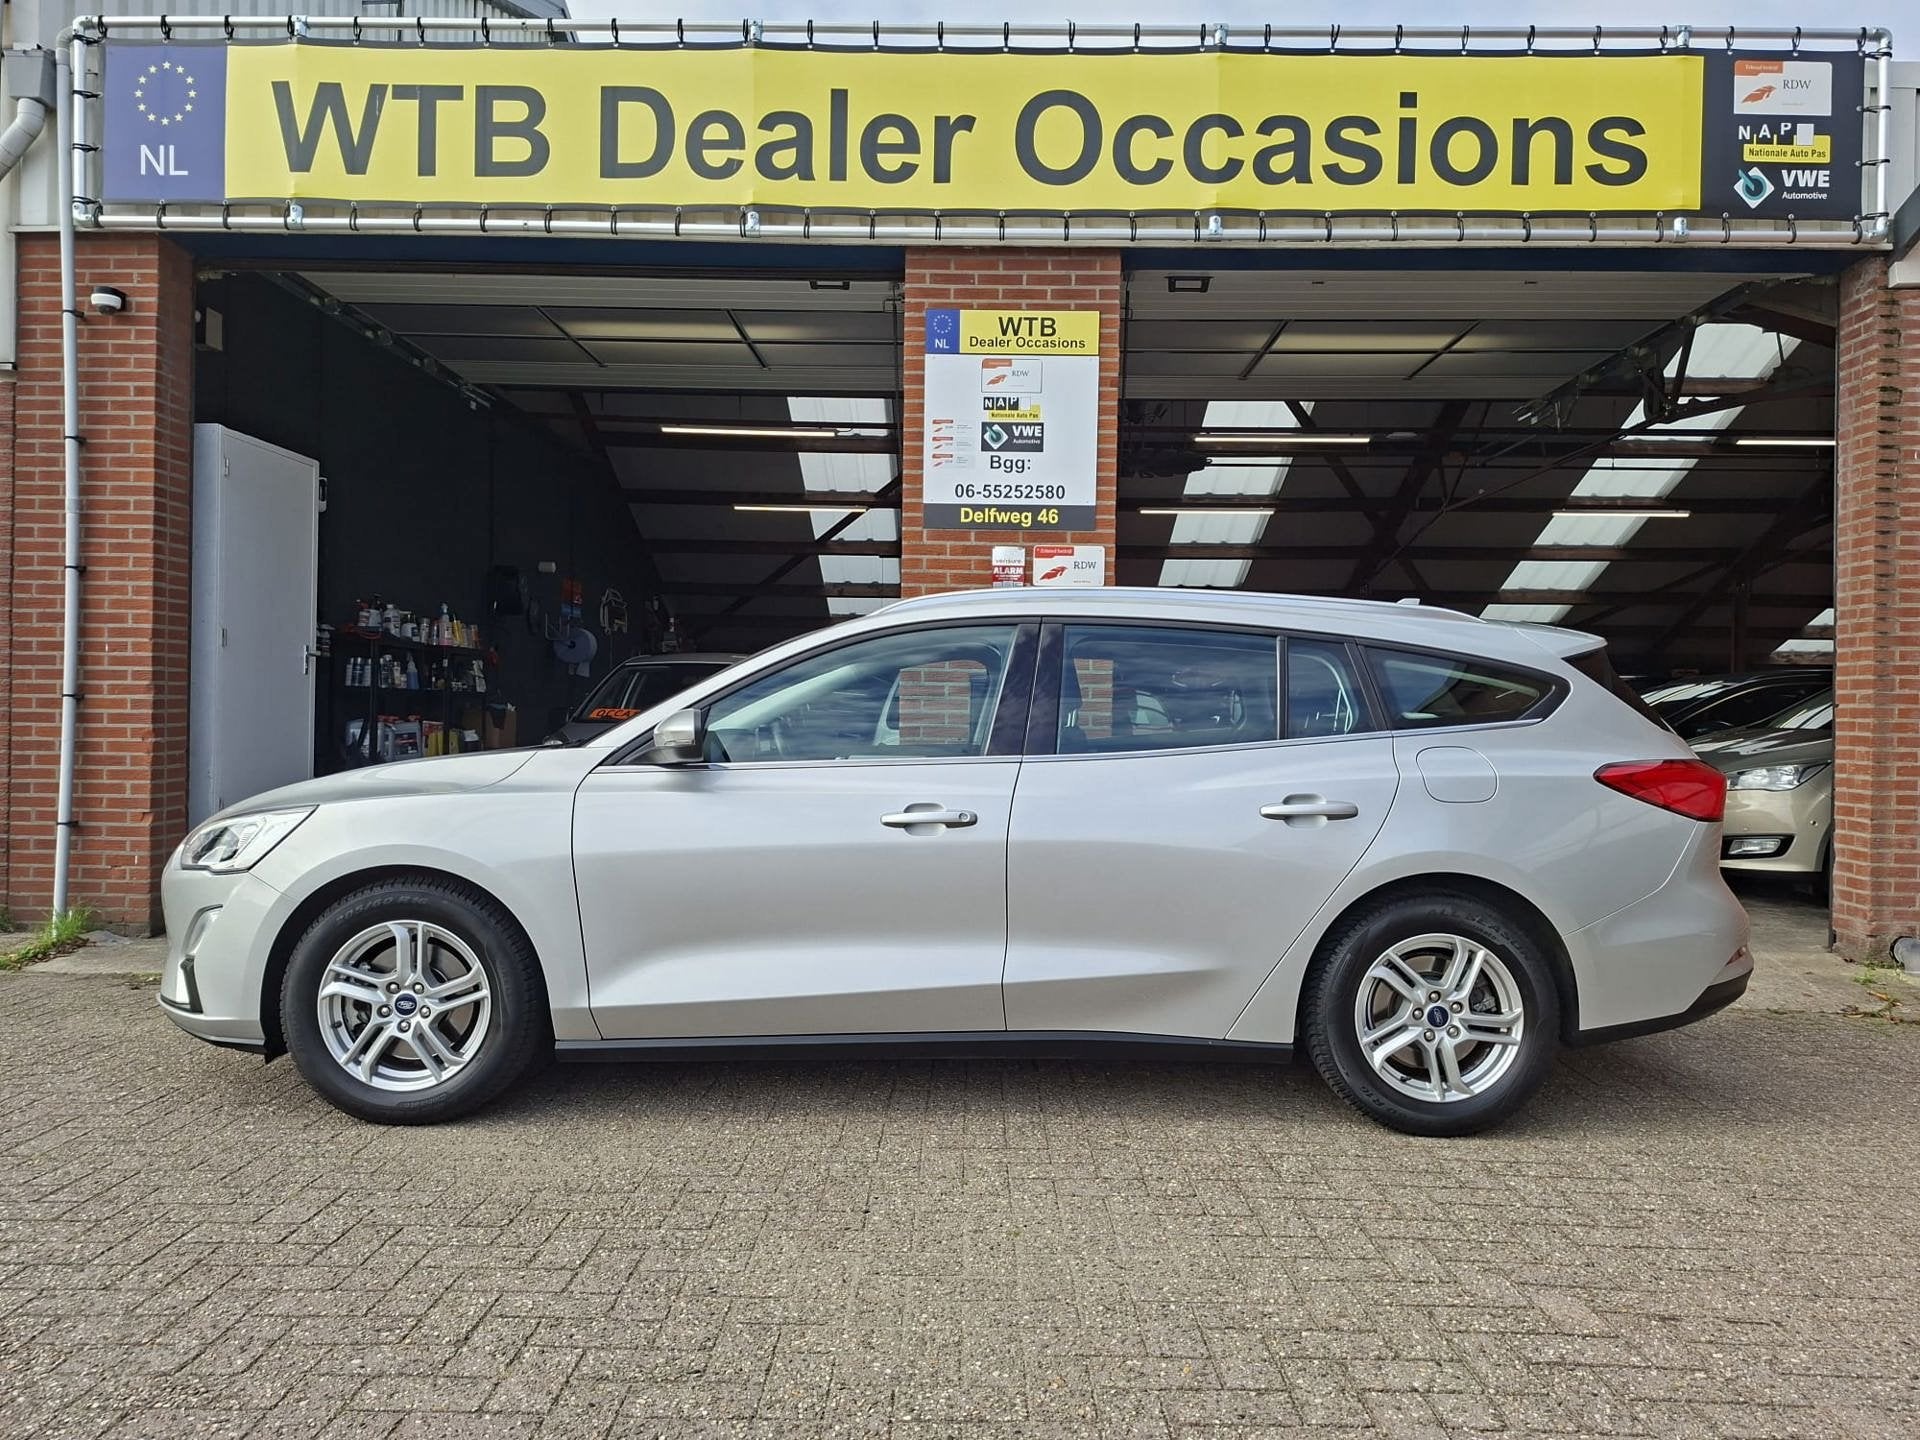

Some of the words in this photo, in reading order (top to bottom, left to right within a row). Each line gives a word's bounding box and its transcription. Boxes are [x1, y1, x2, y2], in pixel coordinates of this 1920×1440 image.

[1782, 79, 1812, 90] RDW
[272, 81, 551, 178] WTB
[600, 86, 976, 184] Dealer
[1015, 90, 1648, 187] Occasions
[1748, 148, 1788, 158] Nationale
[1790, 149, 1809, 158] Auto
[1811, 149, 1826, 158] Pas
[140, 144, 189, 176] NL
[1781, 169, 1830, 188] VWE
[1781, 191, 1828, 200] Automotive
[998, 316, 1057, 337] WTB
[934, 338, 950, 349] NL
[969, 336, 1012, 348] Dealer
[1016, 337, 1086, 349] Occasions
[1012, 425, 1043, 437] VWE
[990, 455, 1031, 474] Bgg:
[954, 483, 1066, 500] 06-55252580
[960, 507, 1033, 528] Delfweg
[1037, 508, 1059, 525] 46
[993, 566, 1024, 575] ALARM
[1073, 560, 1097, 570] RDW
